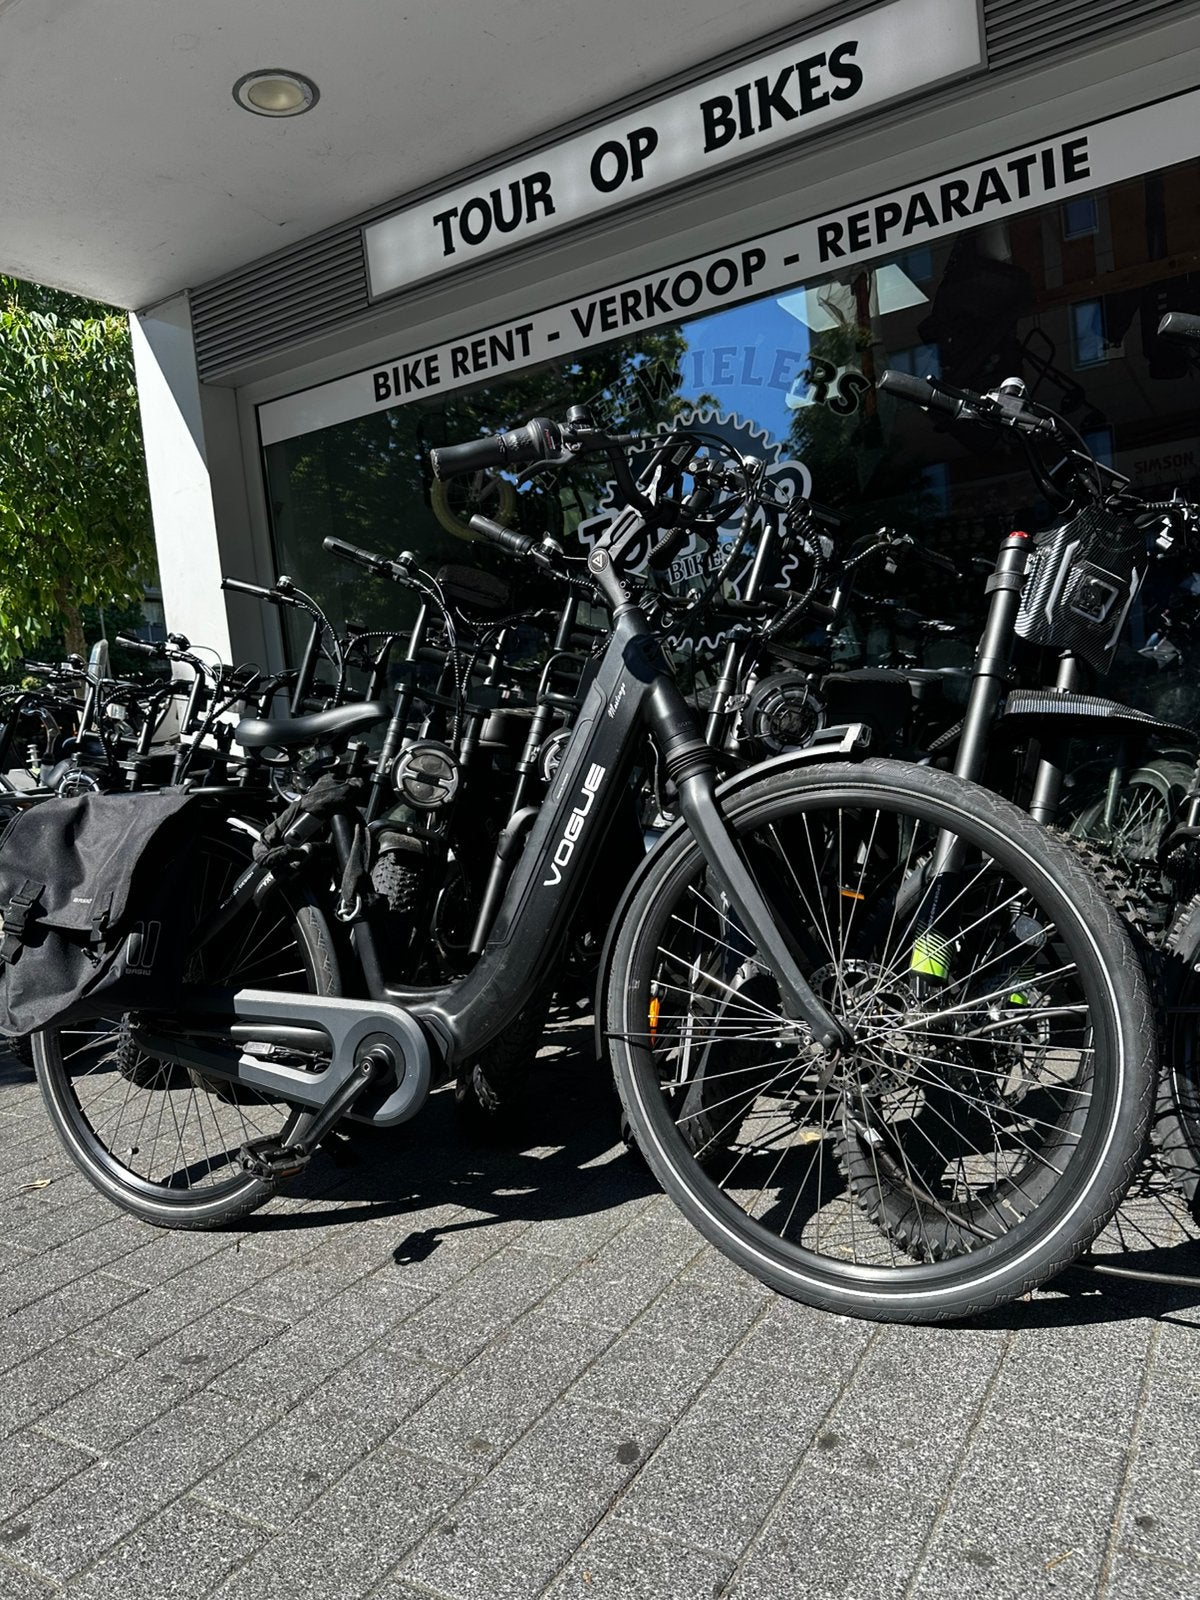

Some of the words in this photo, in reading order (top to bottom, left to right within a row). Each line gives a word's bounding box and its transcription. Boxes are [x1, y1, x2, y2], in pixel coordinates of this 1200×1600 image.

[432, 171, 556, 257] TOUR
[590, 126, 659, 193] OP
[699, 40, 863, 154] BIKES
[372, 353, 441, 403] BIKE
[450, 322, 534, 379] RENT
[570, 247, 767, 339] VERKOOP
[817, 135, 1091, 263] REPARATIE
[1134, 451, 1194, 474] SIMSON
[543, 762, 606, 886] VOGUE
